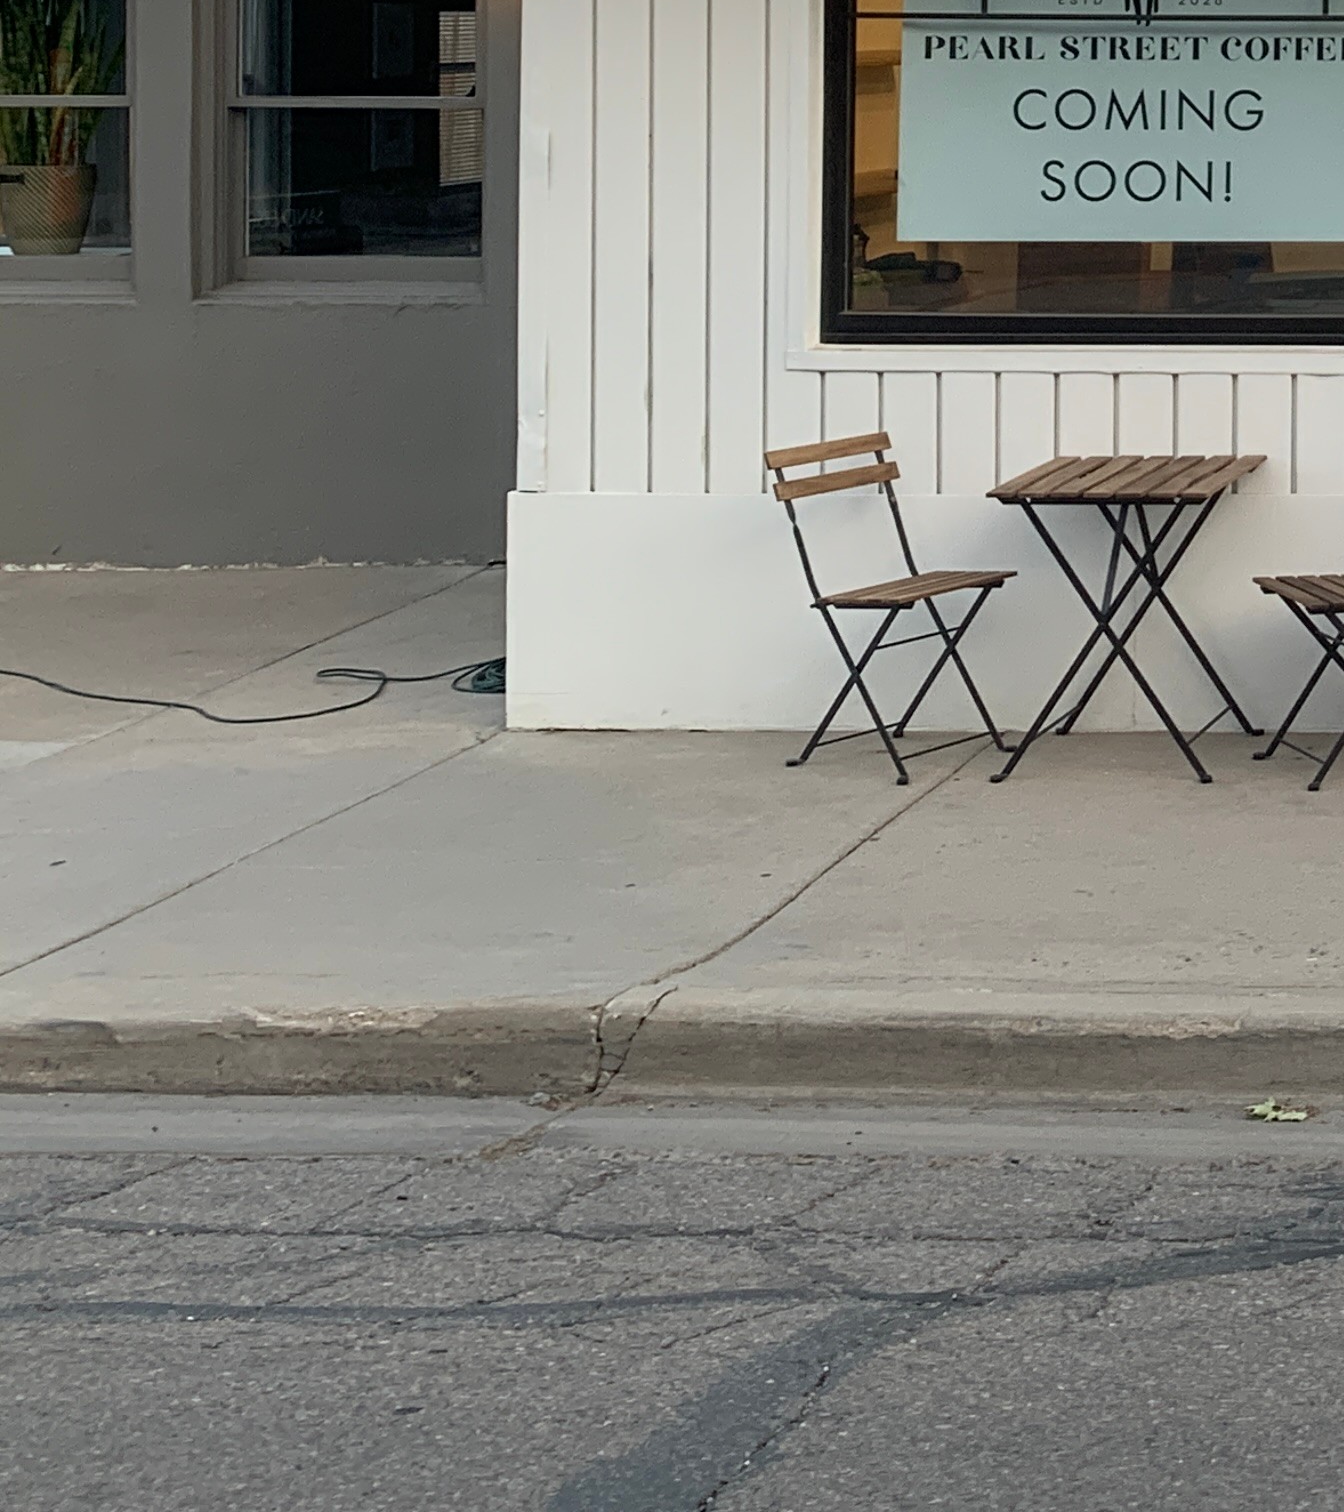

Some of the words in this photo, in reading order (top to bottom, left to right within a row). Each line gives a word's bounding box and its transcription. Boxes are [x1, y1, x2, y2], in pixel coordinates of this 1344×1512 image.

[924, 35, 1045, 61] PEARL
[1060, 36, 1209, 61] STREET
[1013, 88, 1264, 131] COMING
[1040, 159, 1233, 203] SOON!
